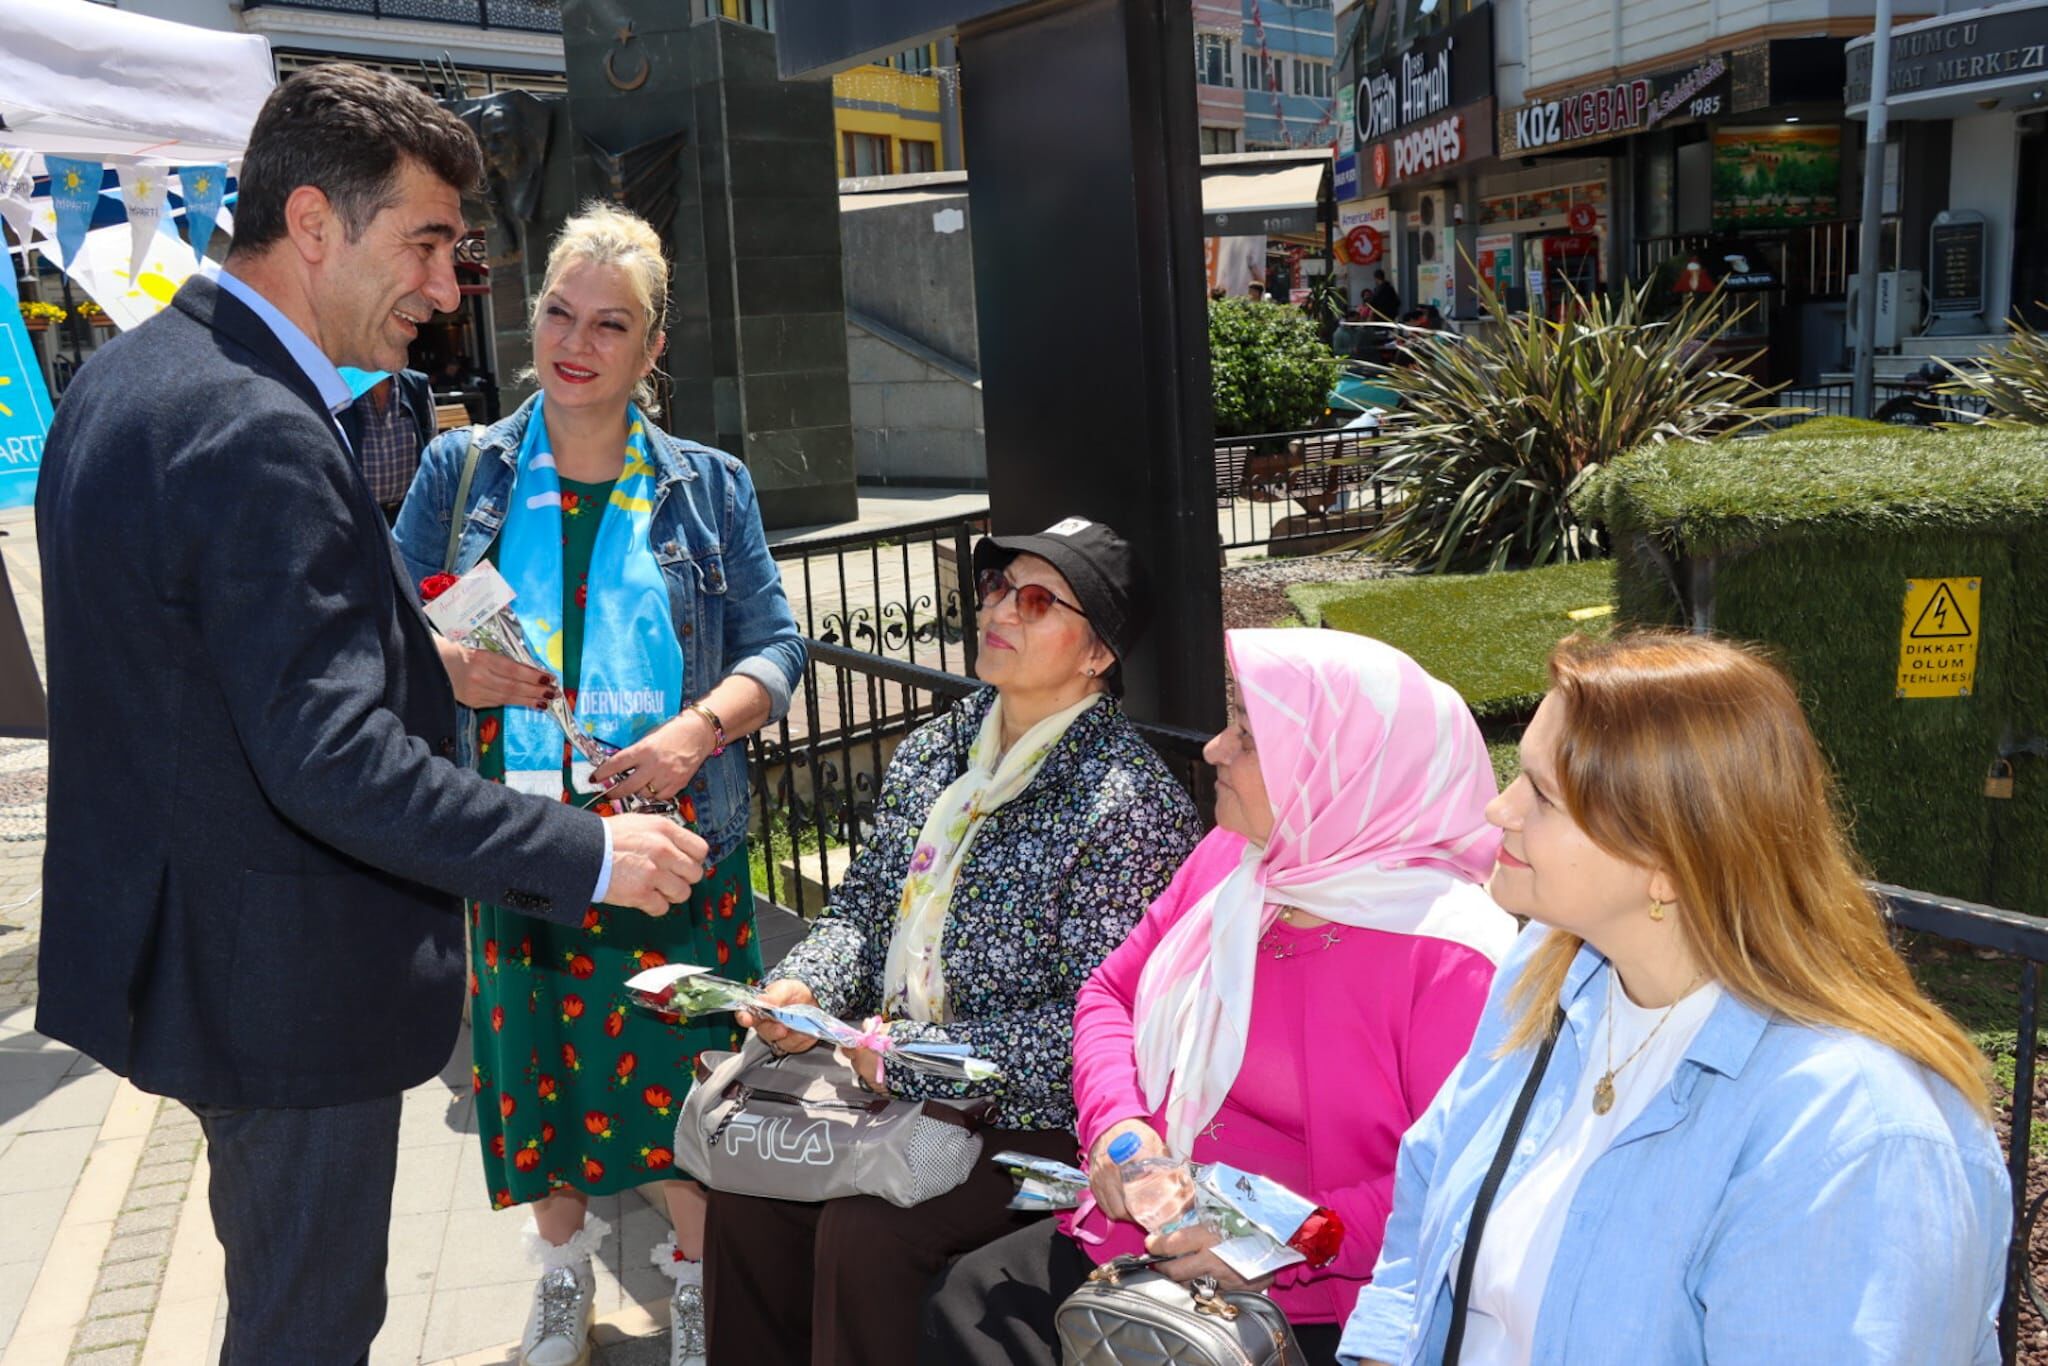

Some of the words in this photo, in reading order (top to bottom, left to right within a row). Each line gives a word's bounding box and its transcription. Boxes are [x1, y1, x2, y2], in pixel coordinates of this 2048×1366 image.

[1896, 23, 1979, 62] MUMCU
[1515, 97, 1561, 150] KÖZ
[1561, 78, 1651, 140] KEBAP
[1689, 95, 1721, 117] 1985
[1394, 115, 1461, 179] POPEYES
[725, 1112, 835, 1166] FILA
